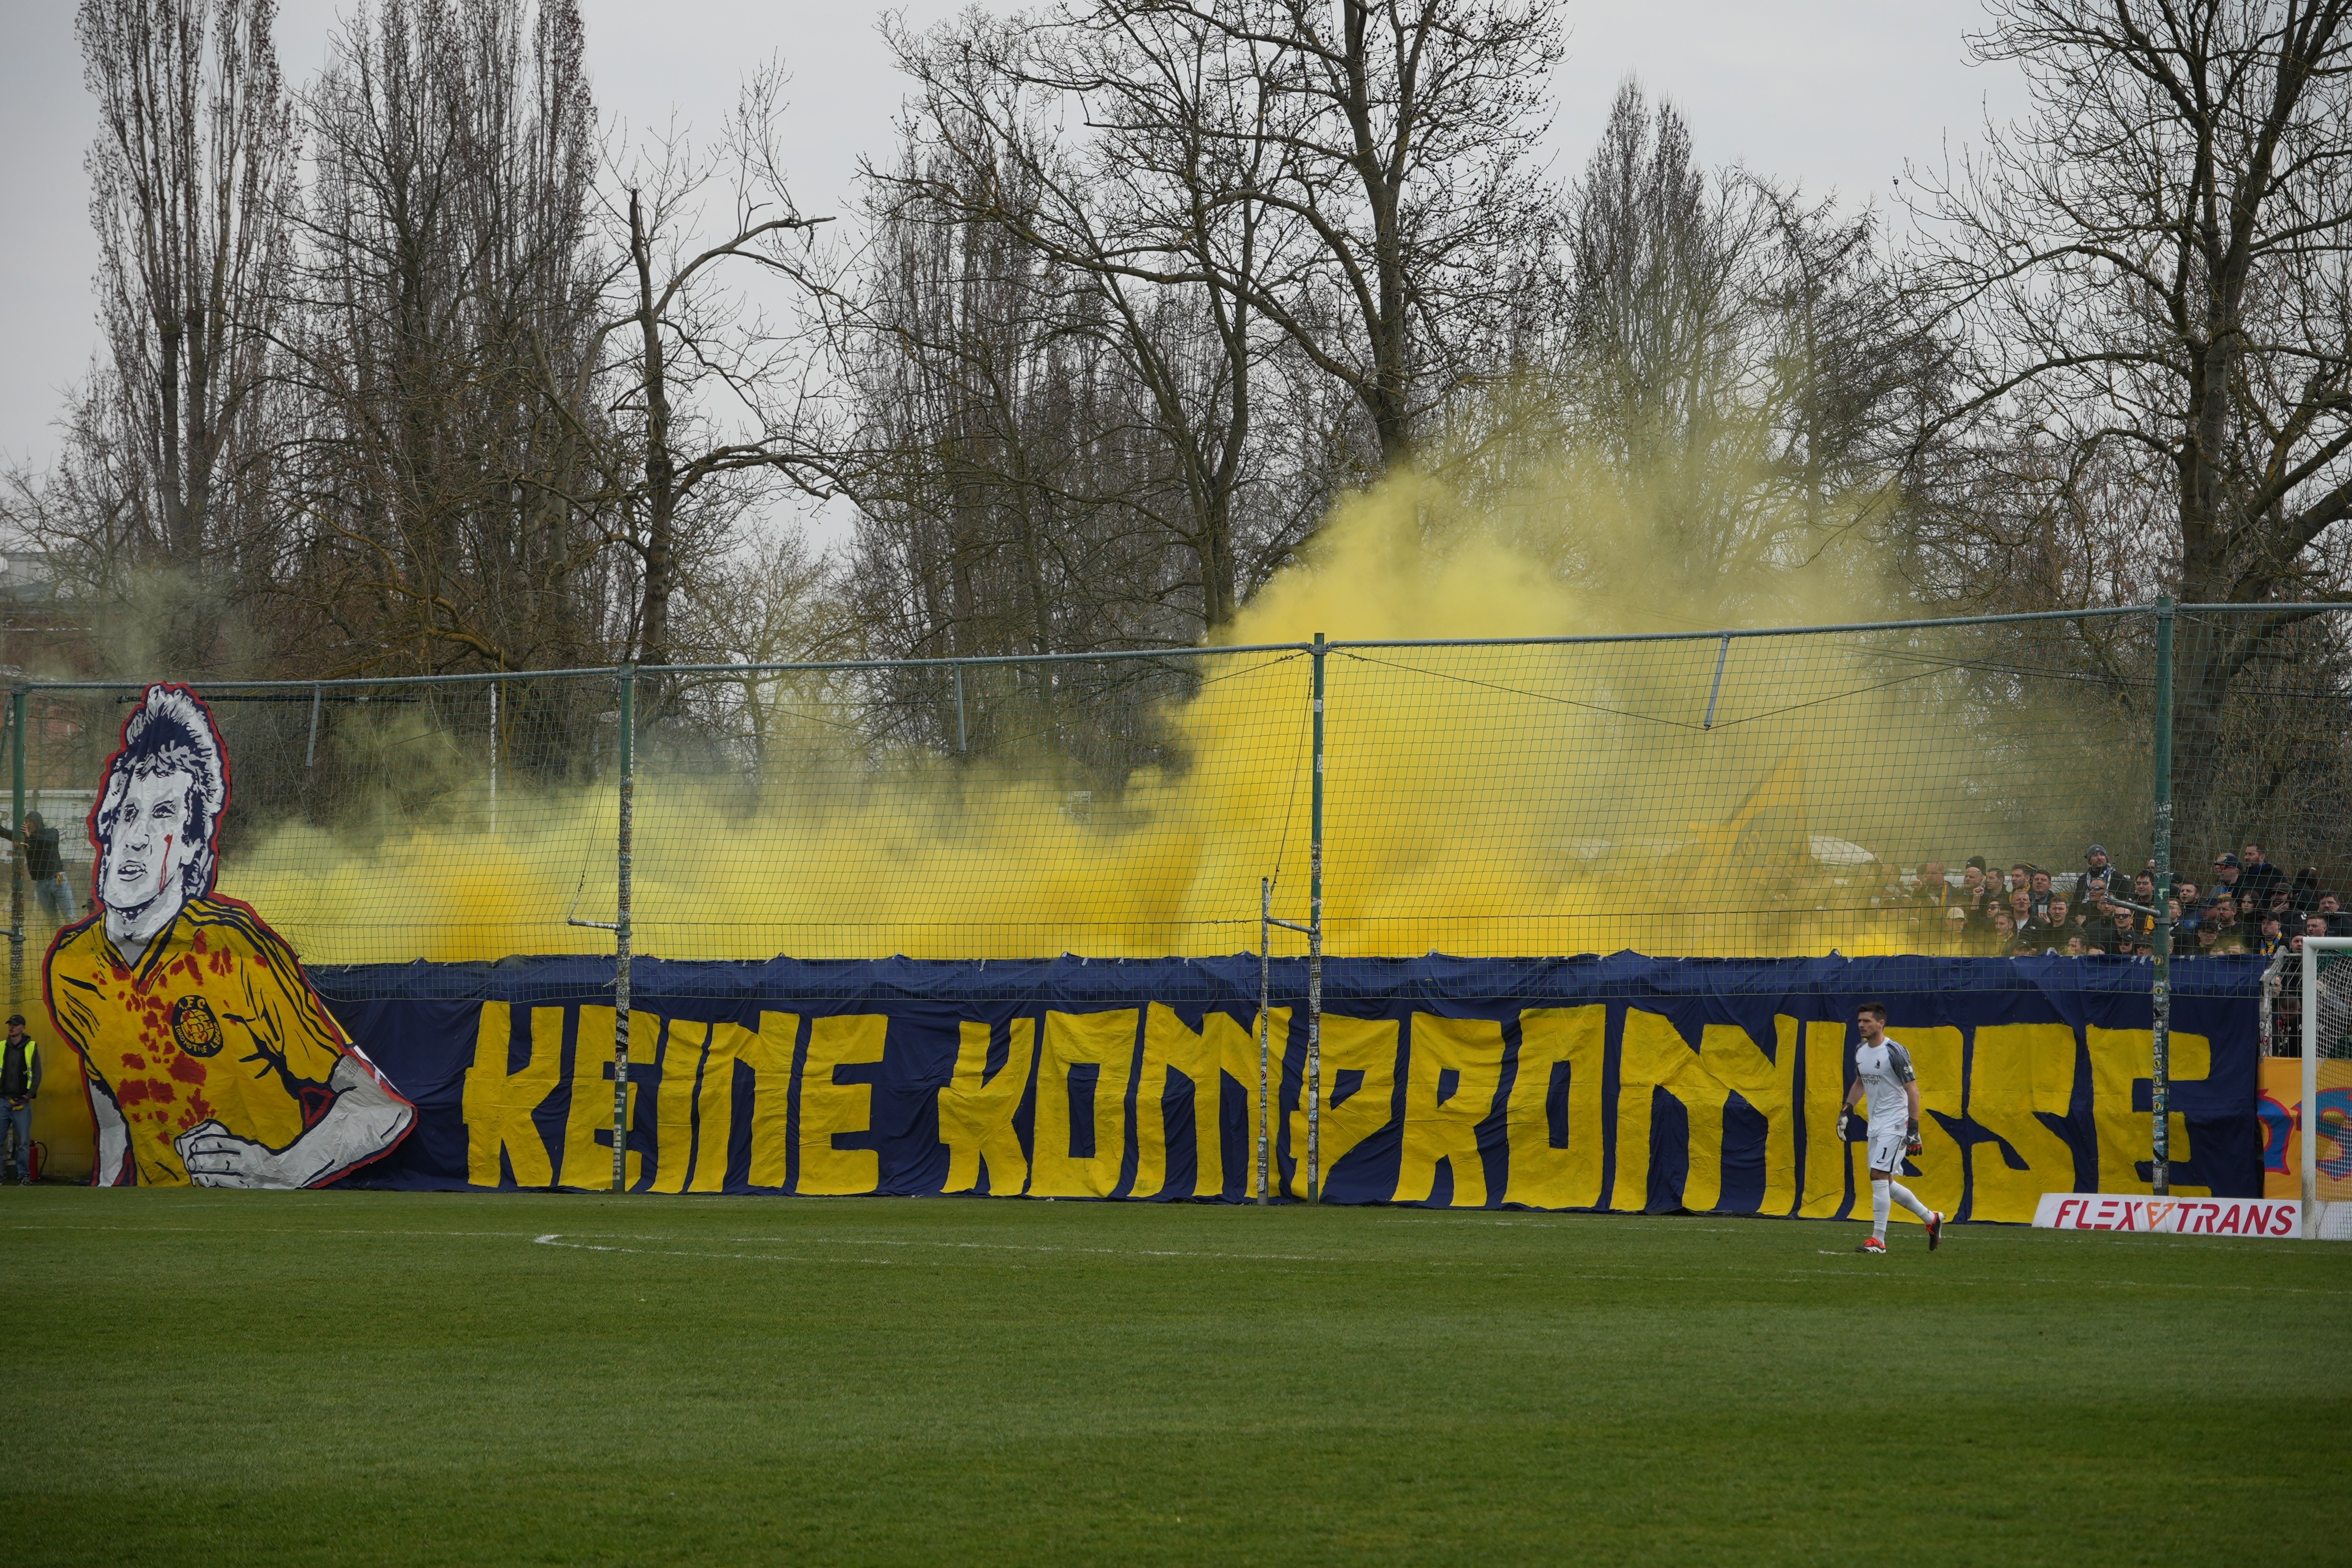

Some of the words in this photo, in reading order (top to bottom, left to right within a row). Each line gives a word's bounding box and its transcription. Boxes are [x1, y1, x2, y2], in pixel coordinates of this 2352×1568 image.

[463, 1001, 888, 1195] KEINE
[938, 1000, 2212, 1222] KOMPROMISSE
[1882, 1147, 1888, 1159] 1
[2054, 1200, 2143, 1231] FLEX
[2176, 1203, 2296, 1235] TRANS
